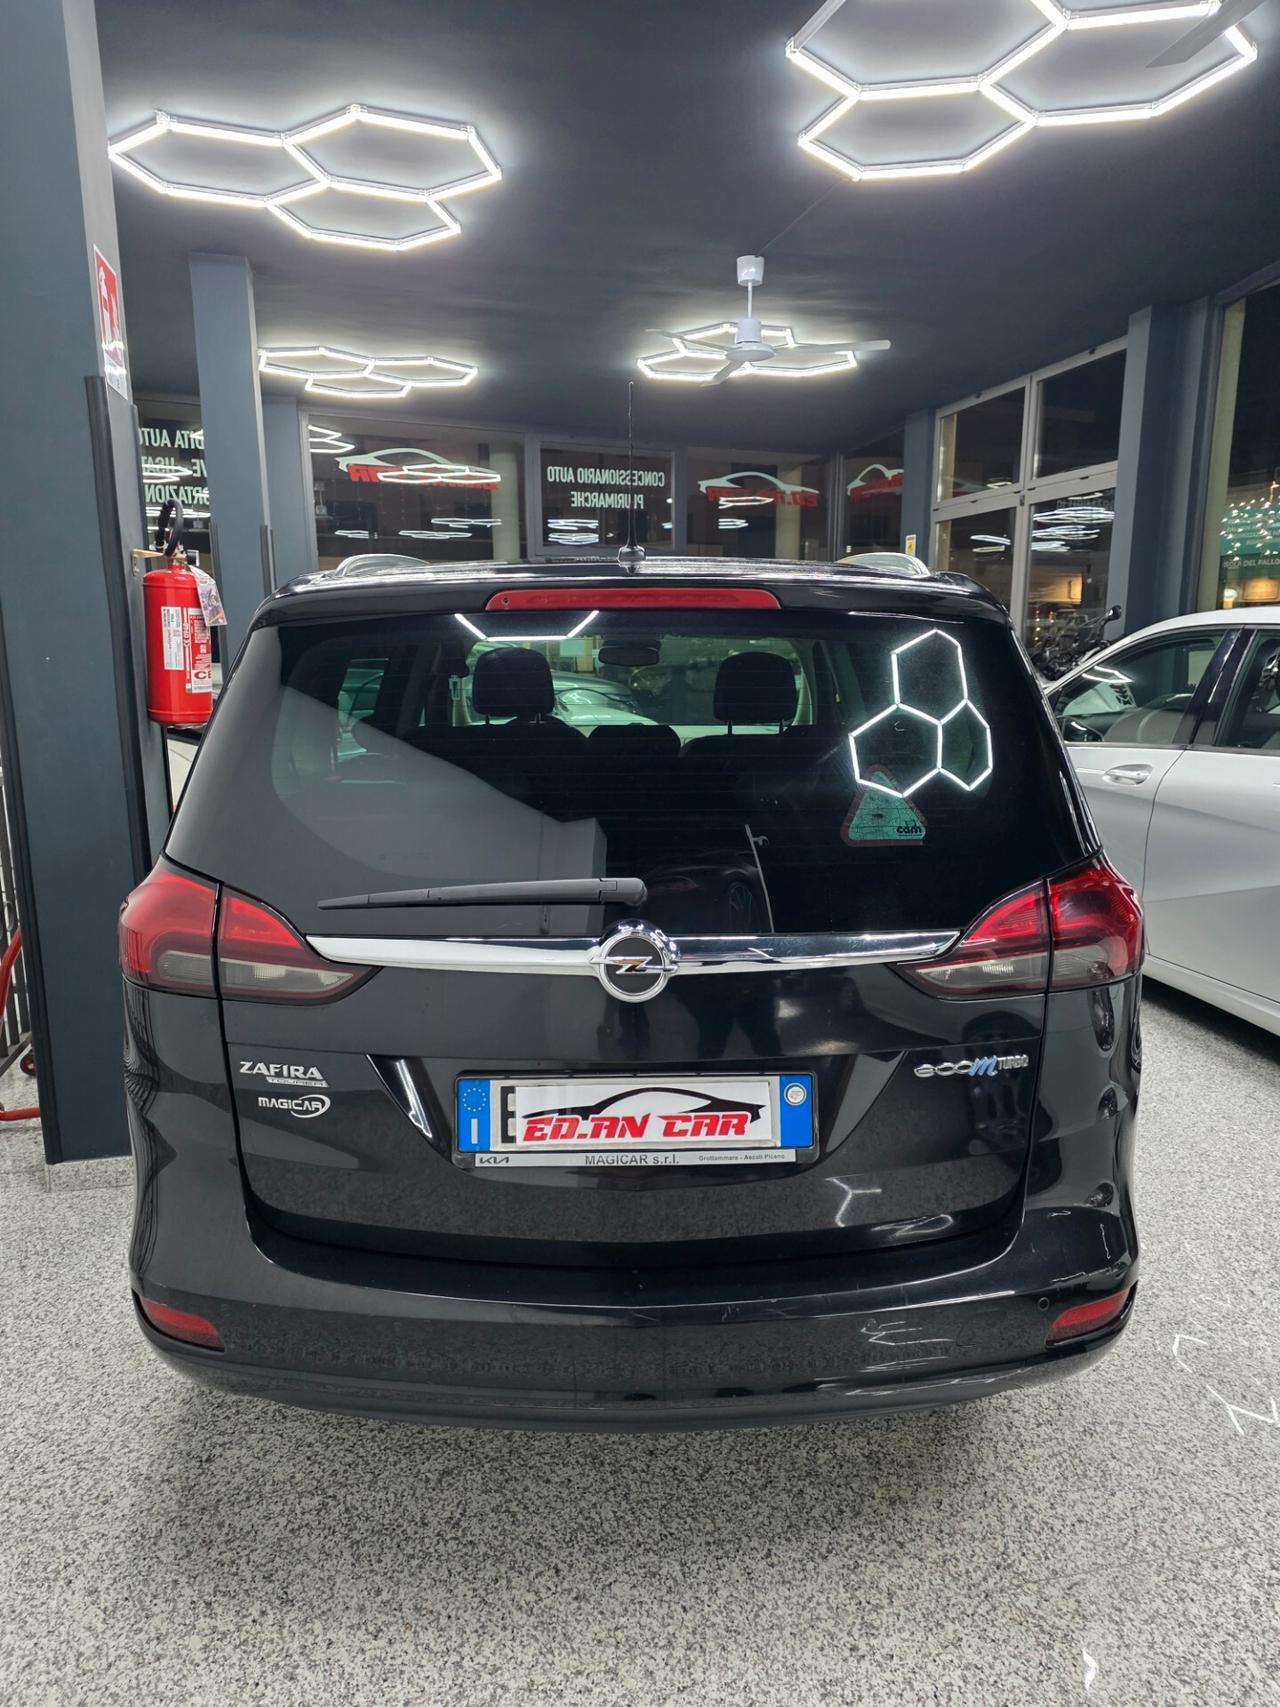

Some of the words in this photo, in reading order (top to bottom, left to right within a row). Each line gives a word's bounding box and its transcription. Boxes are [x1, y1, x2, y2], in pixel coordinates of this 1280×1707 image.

[239, 1061, 324, 1080] ZAFIRA
[257, 1096, 324, 1111] MAGICAR
[522, 1113, 654, 1142] ED.AN
[658, 1111, 752, 1139] CAR
[585, 1154, 648, 1165] MAGICAR
[652, 1153, 680, 1165] s.r.l.
